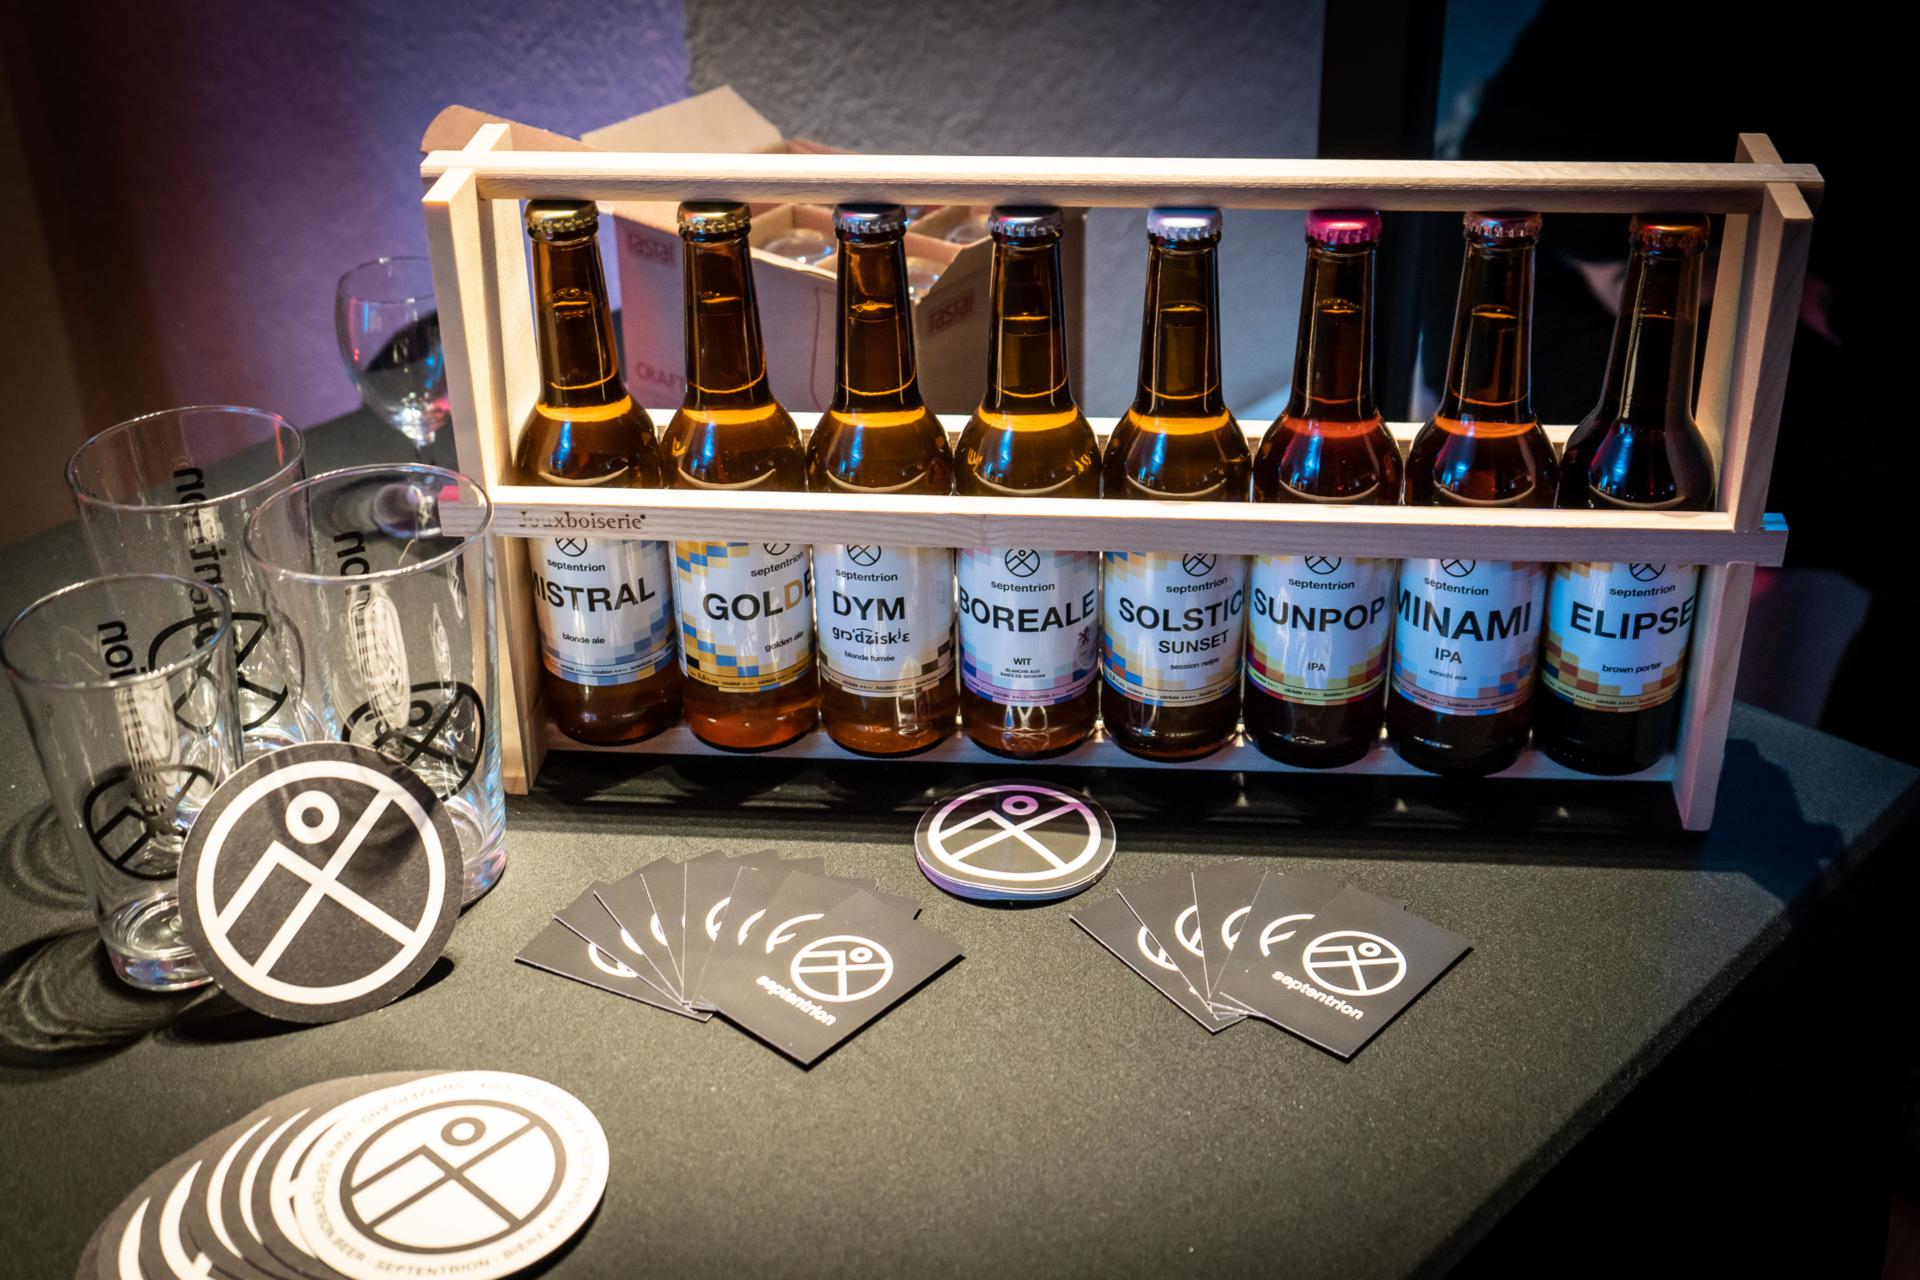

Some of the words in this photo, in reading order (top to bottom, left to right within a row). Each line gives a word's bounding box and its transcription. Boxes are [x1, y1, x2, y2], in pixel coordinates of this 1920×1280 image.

[547, 559, 606, 573] septentrion
[751, 551, 804, 578] septentrion
[836, 569, 898, 582] septentrion
[1288, 578, 1355, 590] septentrion
[991, 581, 1055, 593] septentrion
[1166, 577, 1228, 595] septentrion
[1424, 577, 1489, 596] septentrion
[1609, 584, 1676, 599] septentrion
[832, 590, 905, 622] DYM
[960, 584, 1095, 633] BOREALE
[1119, 584, 1245, 632] SOLSTIC
[1254, 588, 1385, 632] SUNPOP
[1397, 587, 1532, 642] MINAMI
[1570, 595, 1695, 640] ELIPSE
[562, 632, 590, 644] blonde
[592, 636, 606, 645] ale
[764, 636, 793, 653] golden
[1158, 629, 1230, 654] SUNSET
[844, 650, 869, 662] blonde
[1013, 657, 1033, 666] WIT
[1435, 647, 1462, 664] IPA
[1170, 661, 1200, 670] session
[1307, 662, 1327, 672] IPA
[1602, 664, 1634, 674] brown
[1635, 661, 1662, 674] porter
[756, 975, 837, 1026] septentrion
[1272, 970, 1364, 1020] septentrion
